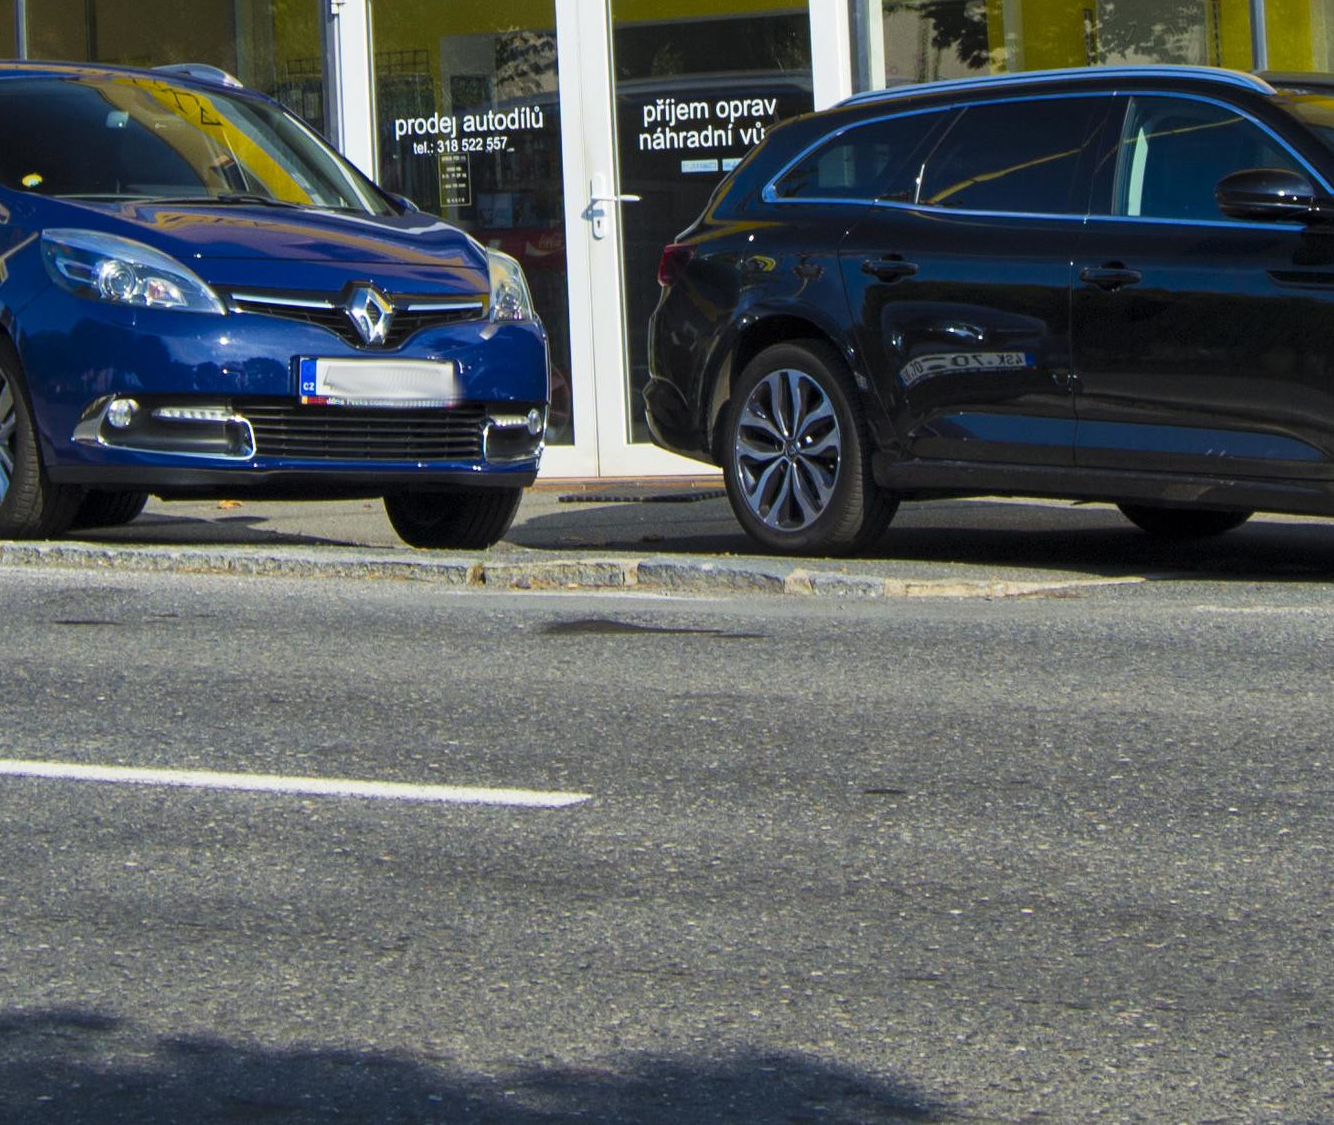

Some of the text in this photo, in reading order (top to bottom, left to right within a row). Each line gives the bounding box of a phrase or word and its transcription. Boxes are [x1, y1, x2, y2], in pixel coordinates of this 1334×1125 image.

[395, 106, 544, 141] prodej autodílů
[643, 98, 777, 128] příjem oprav
[413, 136, 508, 155] tel.: 318 522 557
[639, 124, 733, 151] náhradní
[302, 382, 315, 391] CZ
